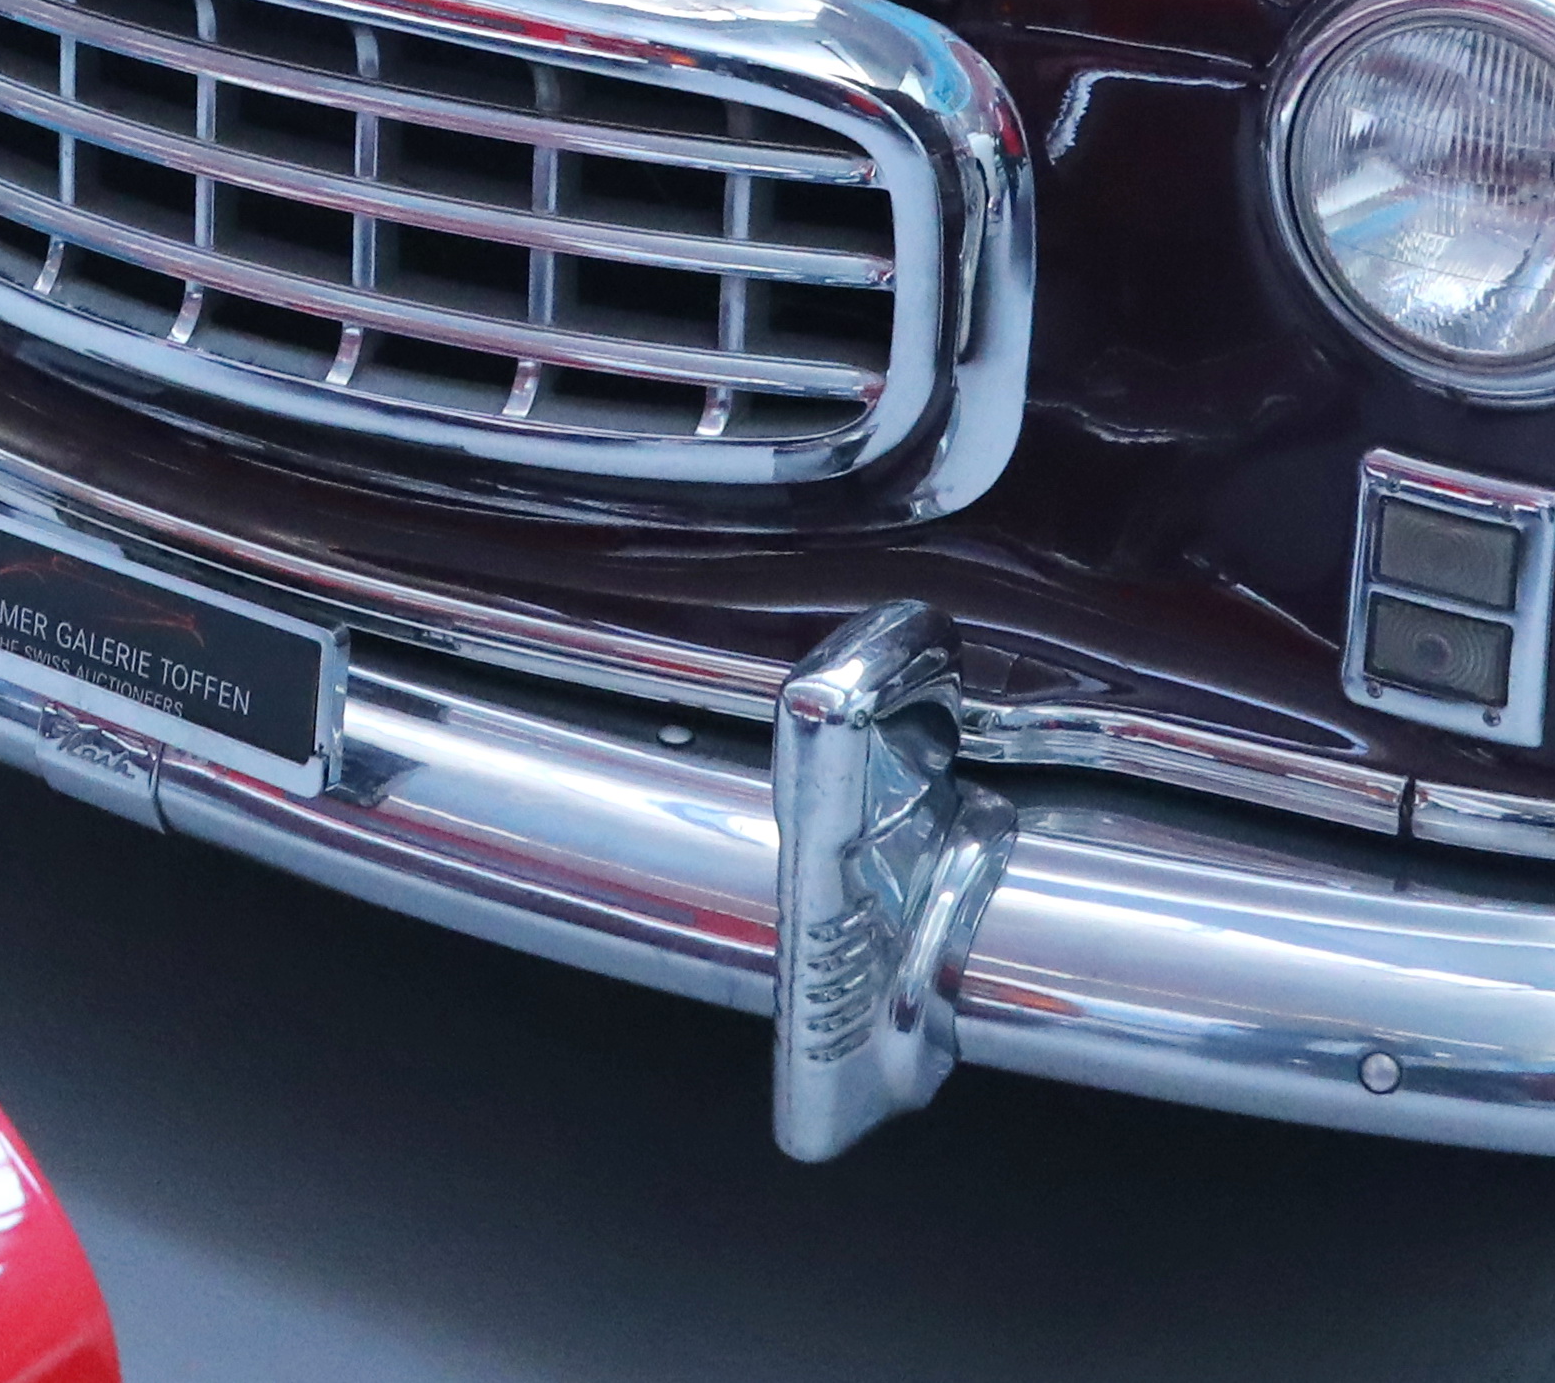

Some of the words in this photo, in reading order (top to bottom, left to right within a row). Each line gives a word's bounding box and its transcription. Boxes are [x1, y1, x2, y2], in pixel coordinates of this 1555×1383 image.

[24, 645, 71, 674] SWISS
[75, 664, 184, 718] AUCTIONEERS
[55, 622, 154, 679] GALERIE
[160, 656, 251, 716] TOFFEN
